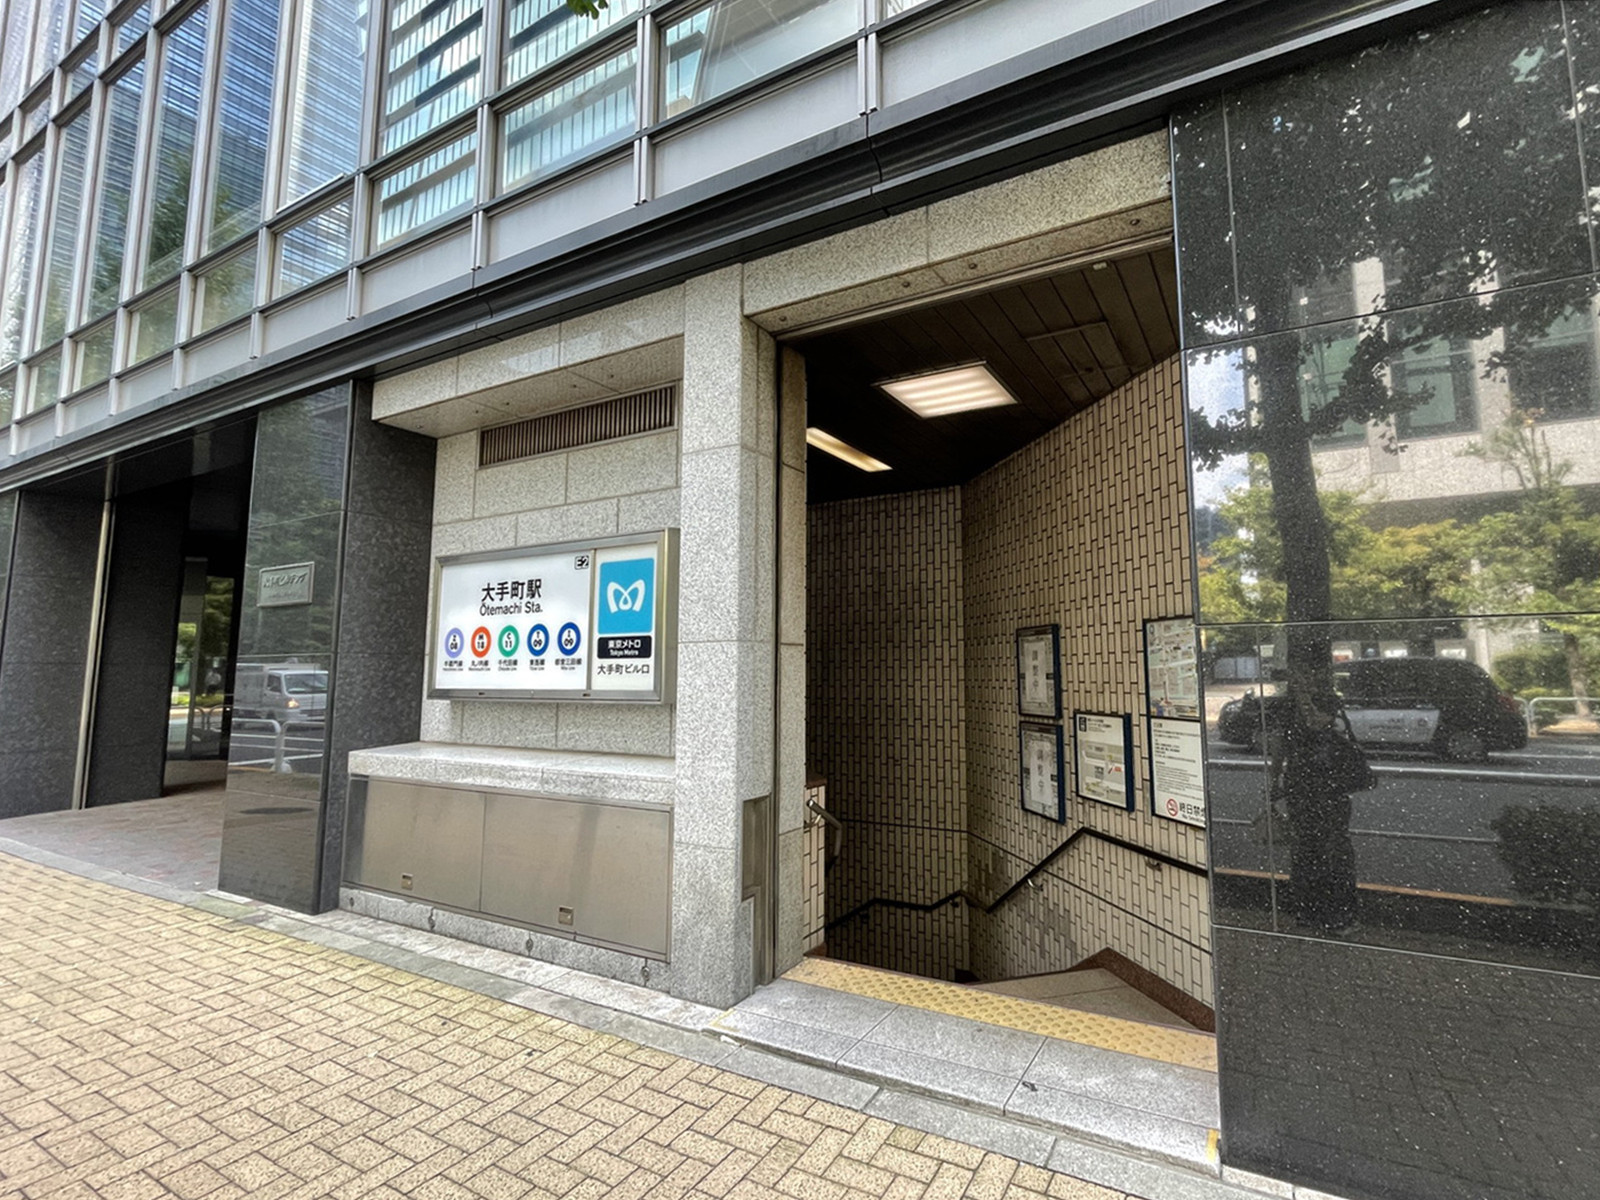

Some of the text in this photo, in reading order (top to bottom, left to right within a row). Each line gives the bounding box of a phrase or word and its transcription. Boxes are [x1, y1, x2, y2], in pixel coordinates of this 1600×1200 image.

[481, 579, 542, 601] 大手町駅
[524, 601, 543, 613] Sta.
[532, 638, 543, 648] 09
[563, 638, 574, 647] 09
[608, 639, 641, 649] 東京メトロ
[597, 663, 650, 675] 大手町ビル口
